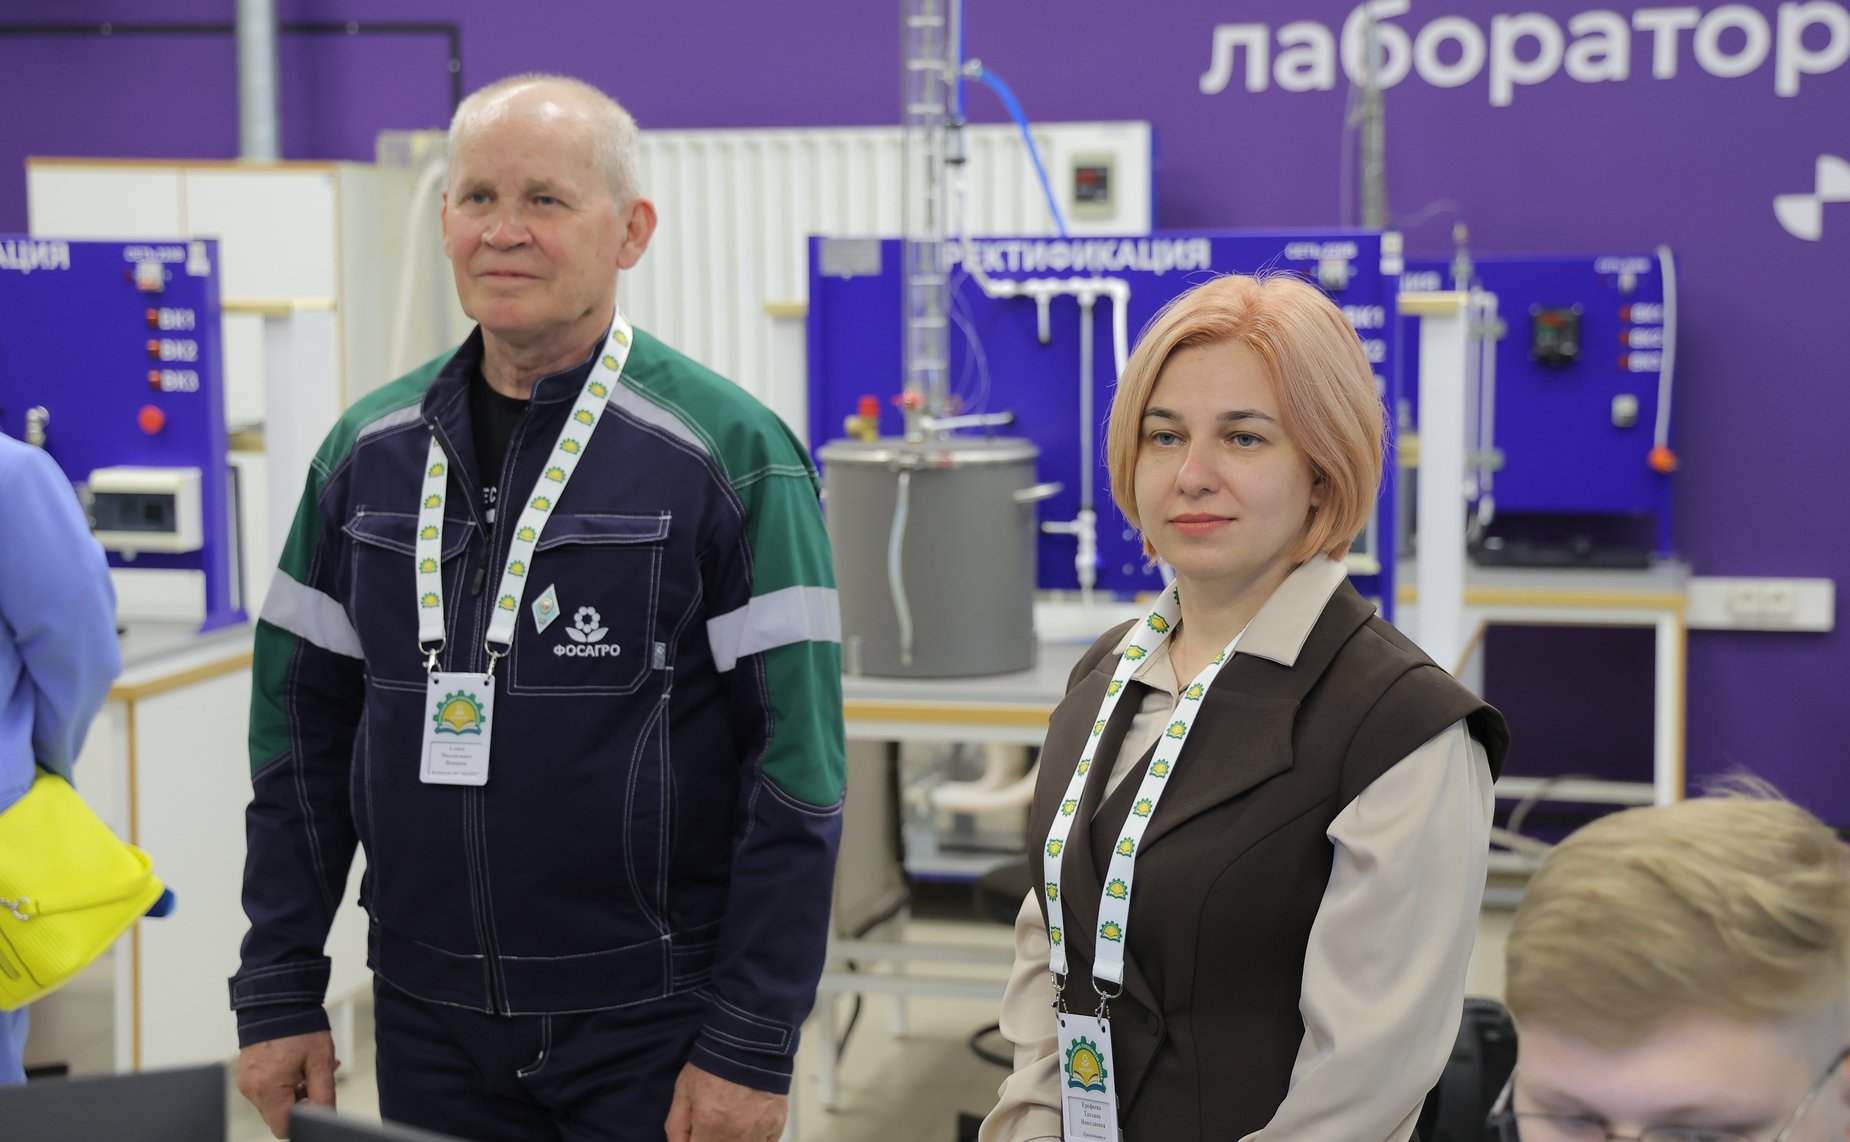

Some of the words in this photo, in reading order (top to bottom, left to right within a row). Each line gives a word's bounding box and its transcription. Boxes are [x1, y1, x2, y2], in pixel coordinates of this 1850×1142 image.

[1199, 0, 1850, 107] лаборатор
[941, 238, 1211, 276] РЕКТИФИКАЦИЯ
[158, 308, 195, 330] ВК1
[159, 338, 198, 361] ВК2
[553, 644, 621, 657] ФОСАГРО
